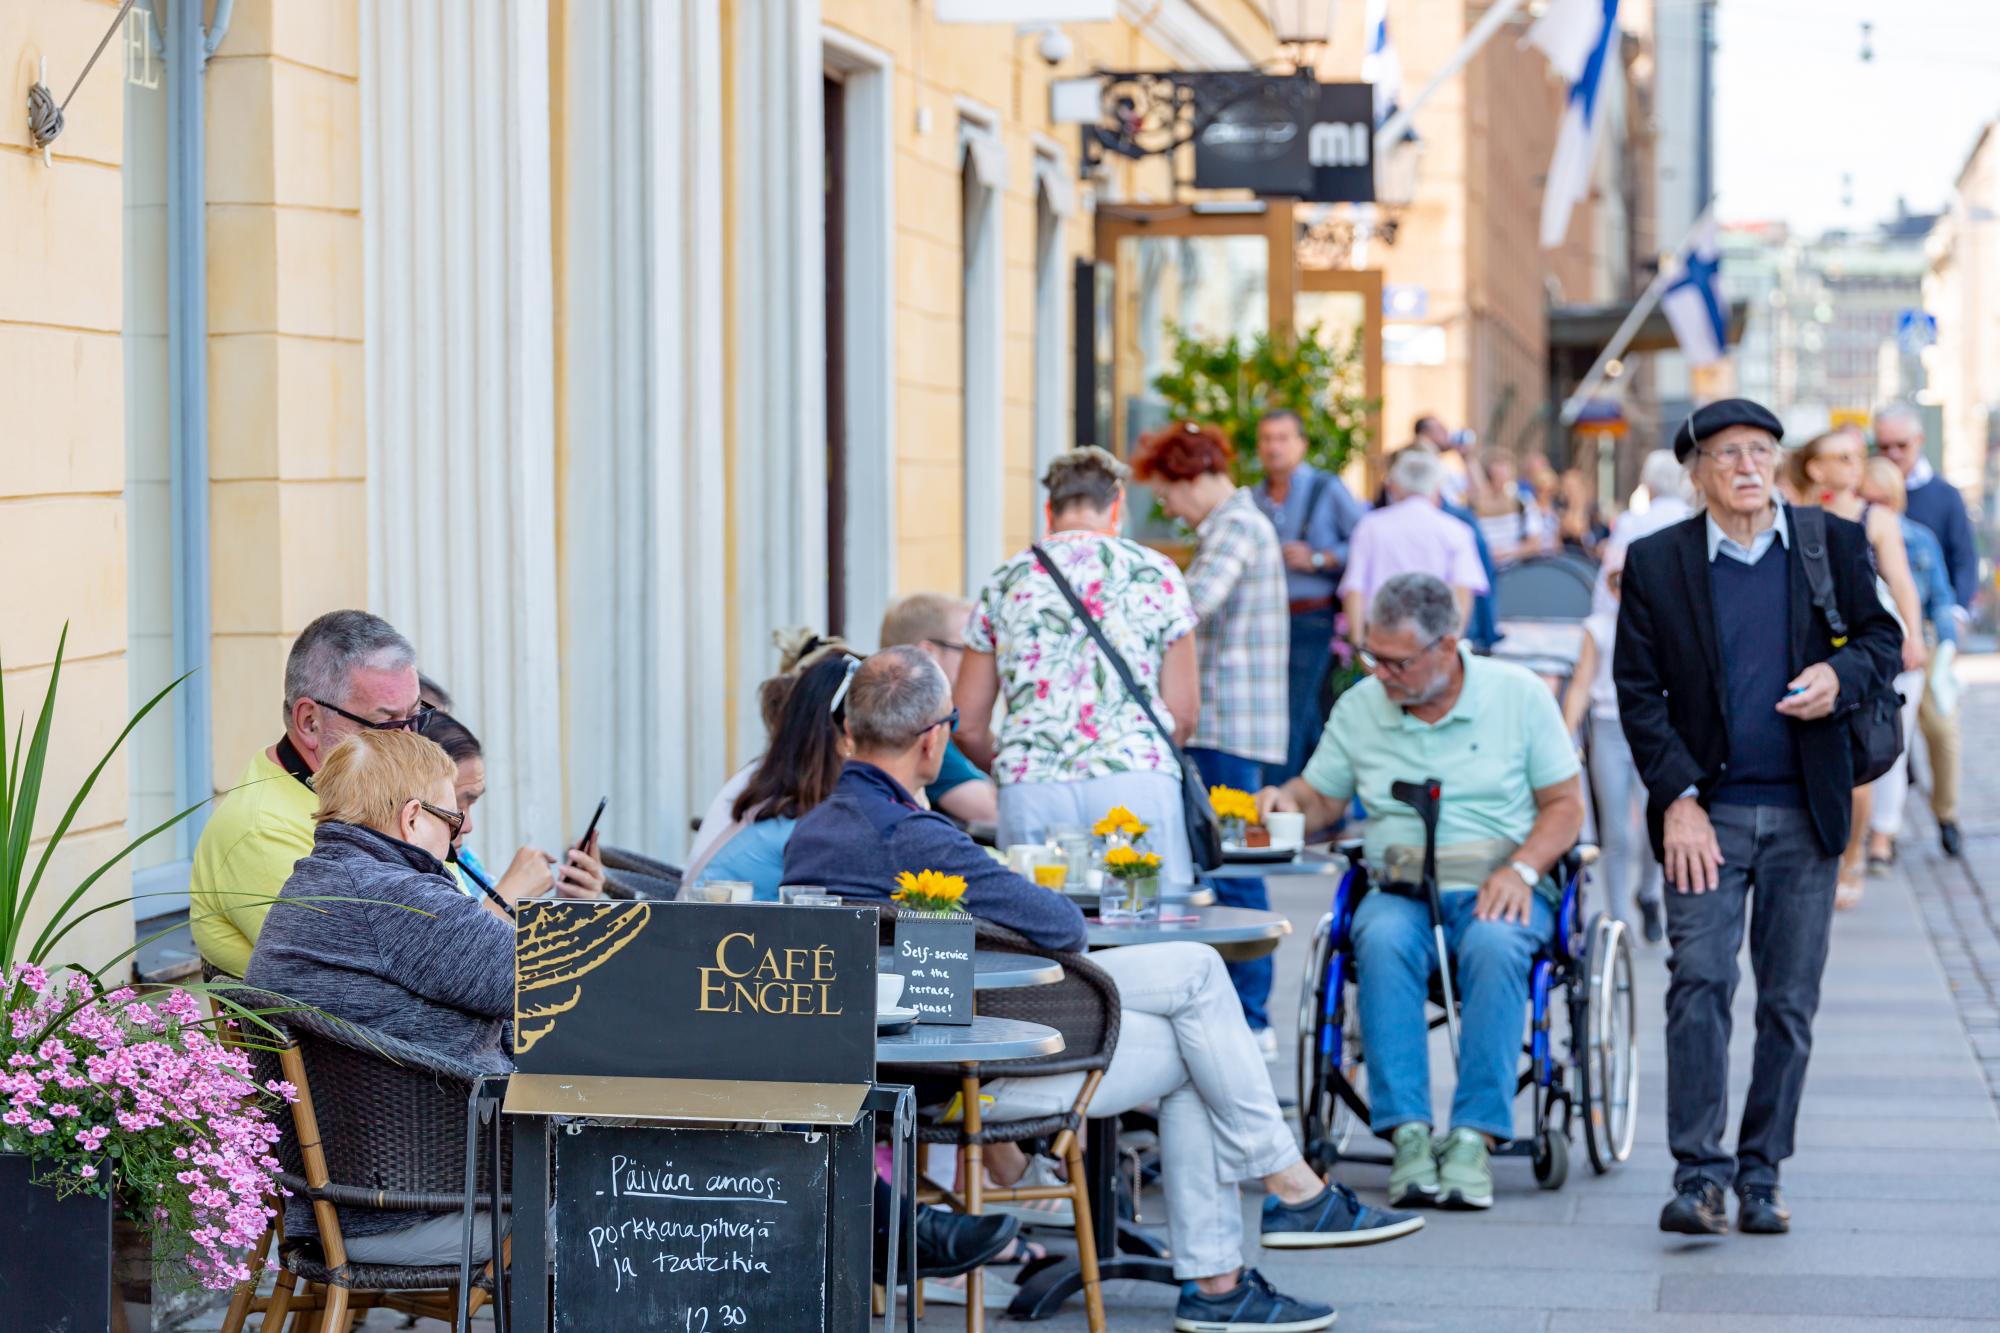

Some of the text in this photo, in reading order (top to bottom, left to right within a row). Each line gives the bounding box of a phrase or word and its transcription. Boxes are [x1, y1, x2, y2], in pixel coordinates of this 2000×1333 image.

[124, 6, 159, 90] EL
[902, 940, 969, 964] Self-service
[911, 968, 950, 979] on the
[695, 966, 844, 1015] ENGEL
[909, 984, 954, 999] terrace,
[611, 1154, 694, 1197] Päivän
[613, 1246, 638, 1293] ja
